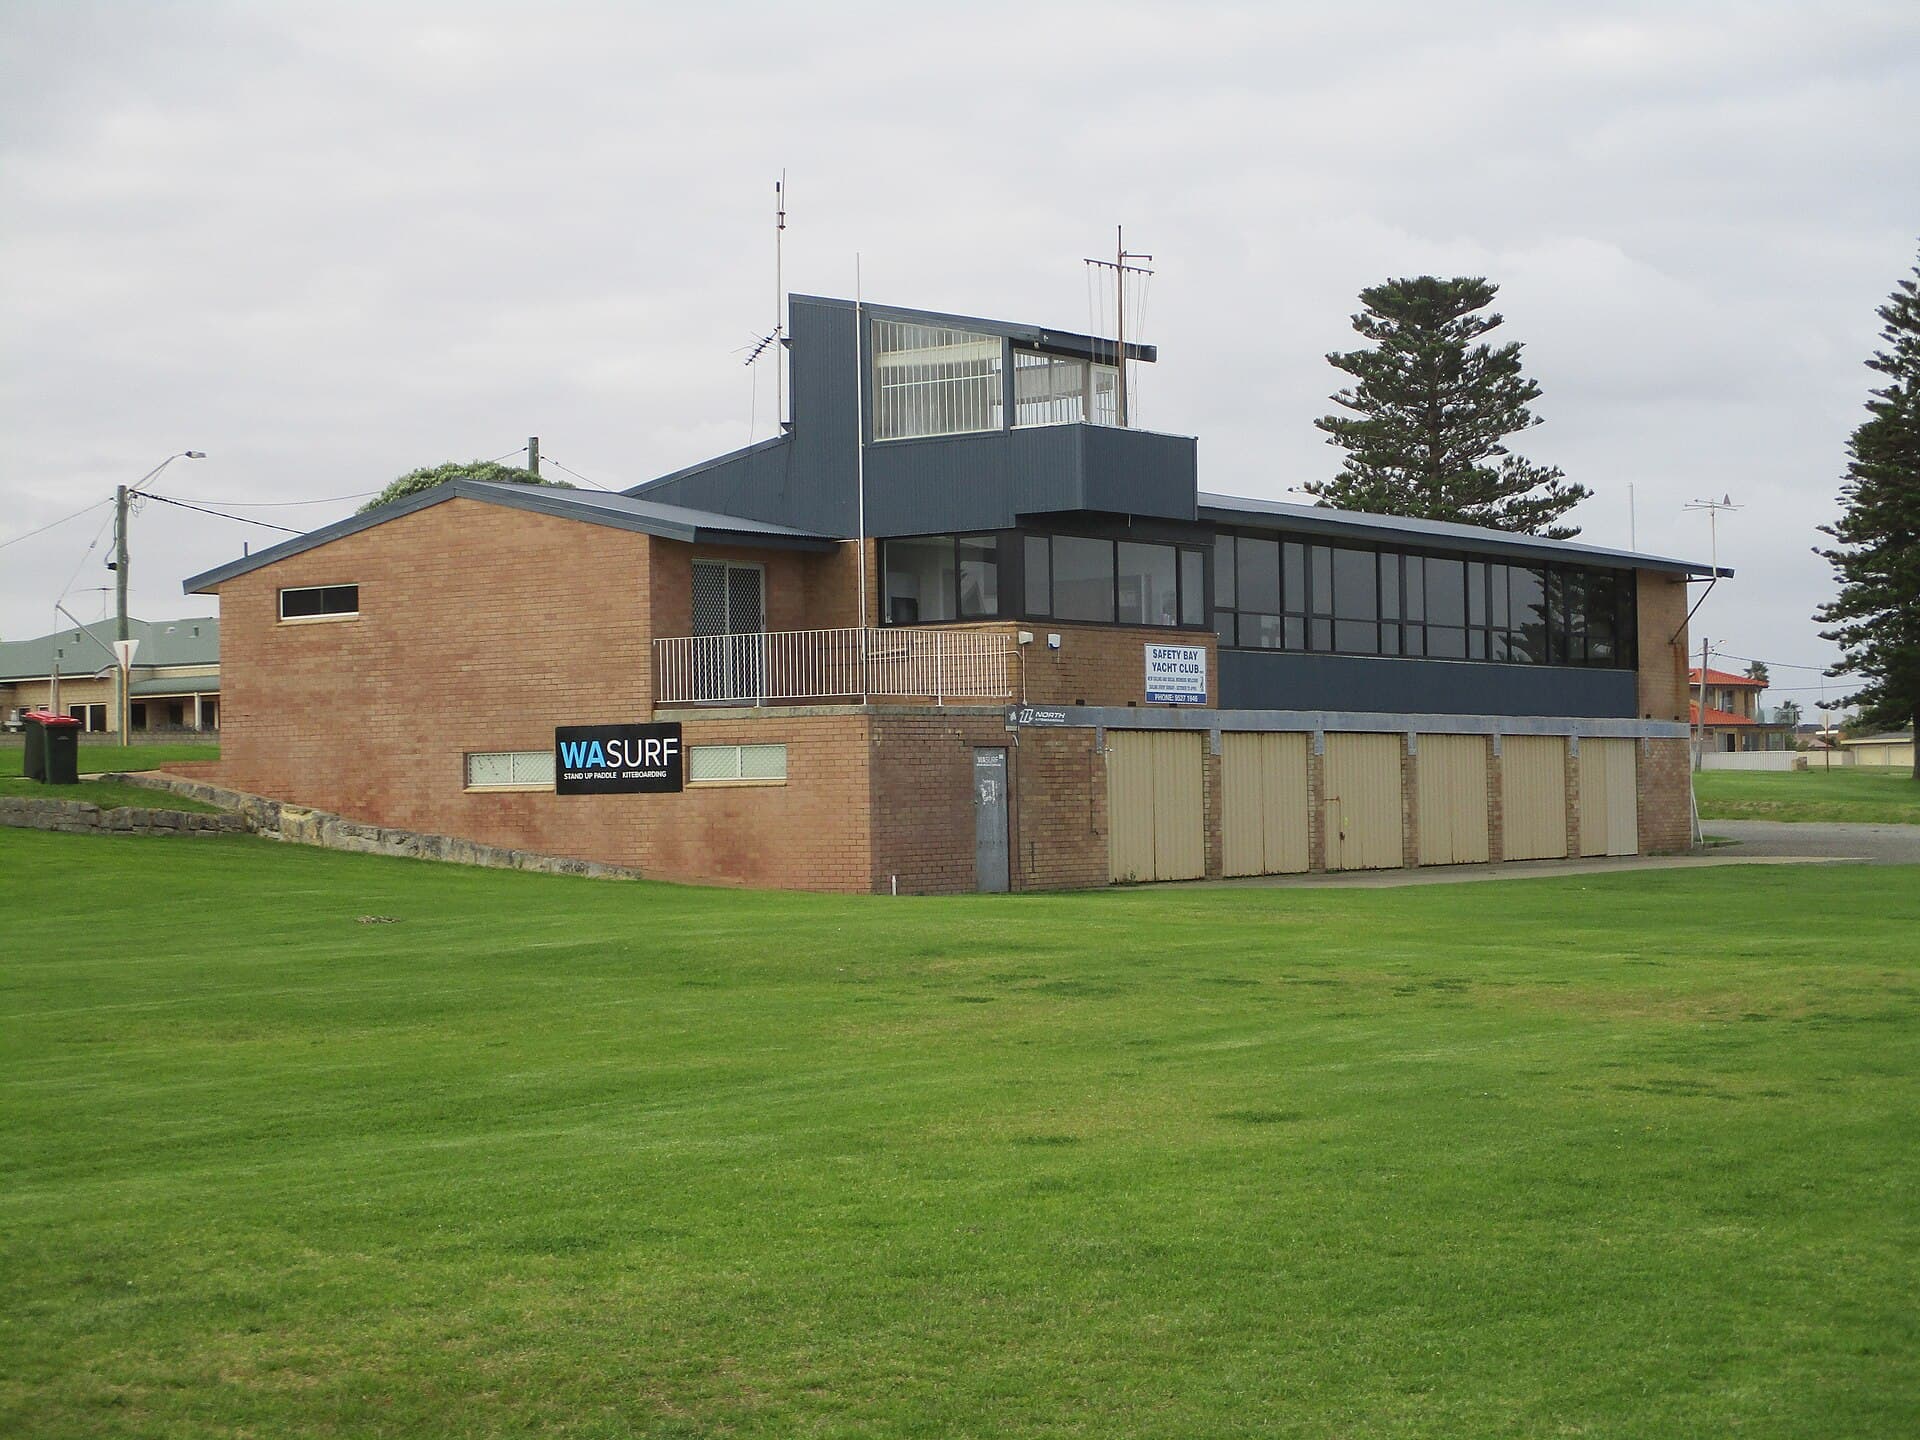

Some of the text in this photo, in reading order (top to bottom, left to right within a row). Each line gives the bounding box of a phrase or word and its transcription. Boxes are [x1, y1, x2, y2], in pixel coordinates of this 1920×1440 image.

[1153, 649, 1198, 660] SAFETY BAY
[1152, 662, 1199, 674] YACHT CLUB
[1035, 711, 1066, 719] NORTH
[594, 771, 617, 779] PADDLE
[622, 770, 667, 779] KITEBOARDING
